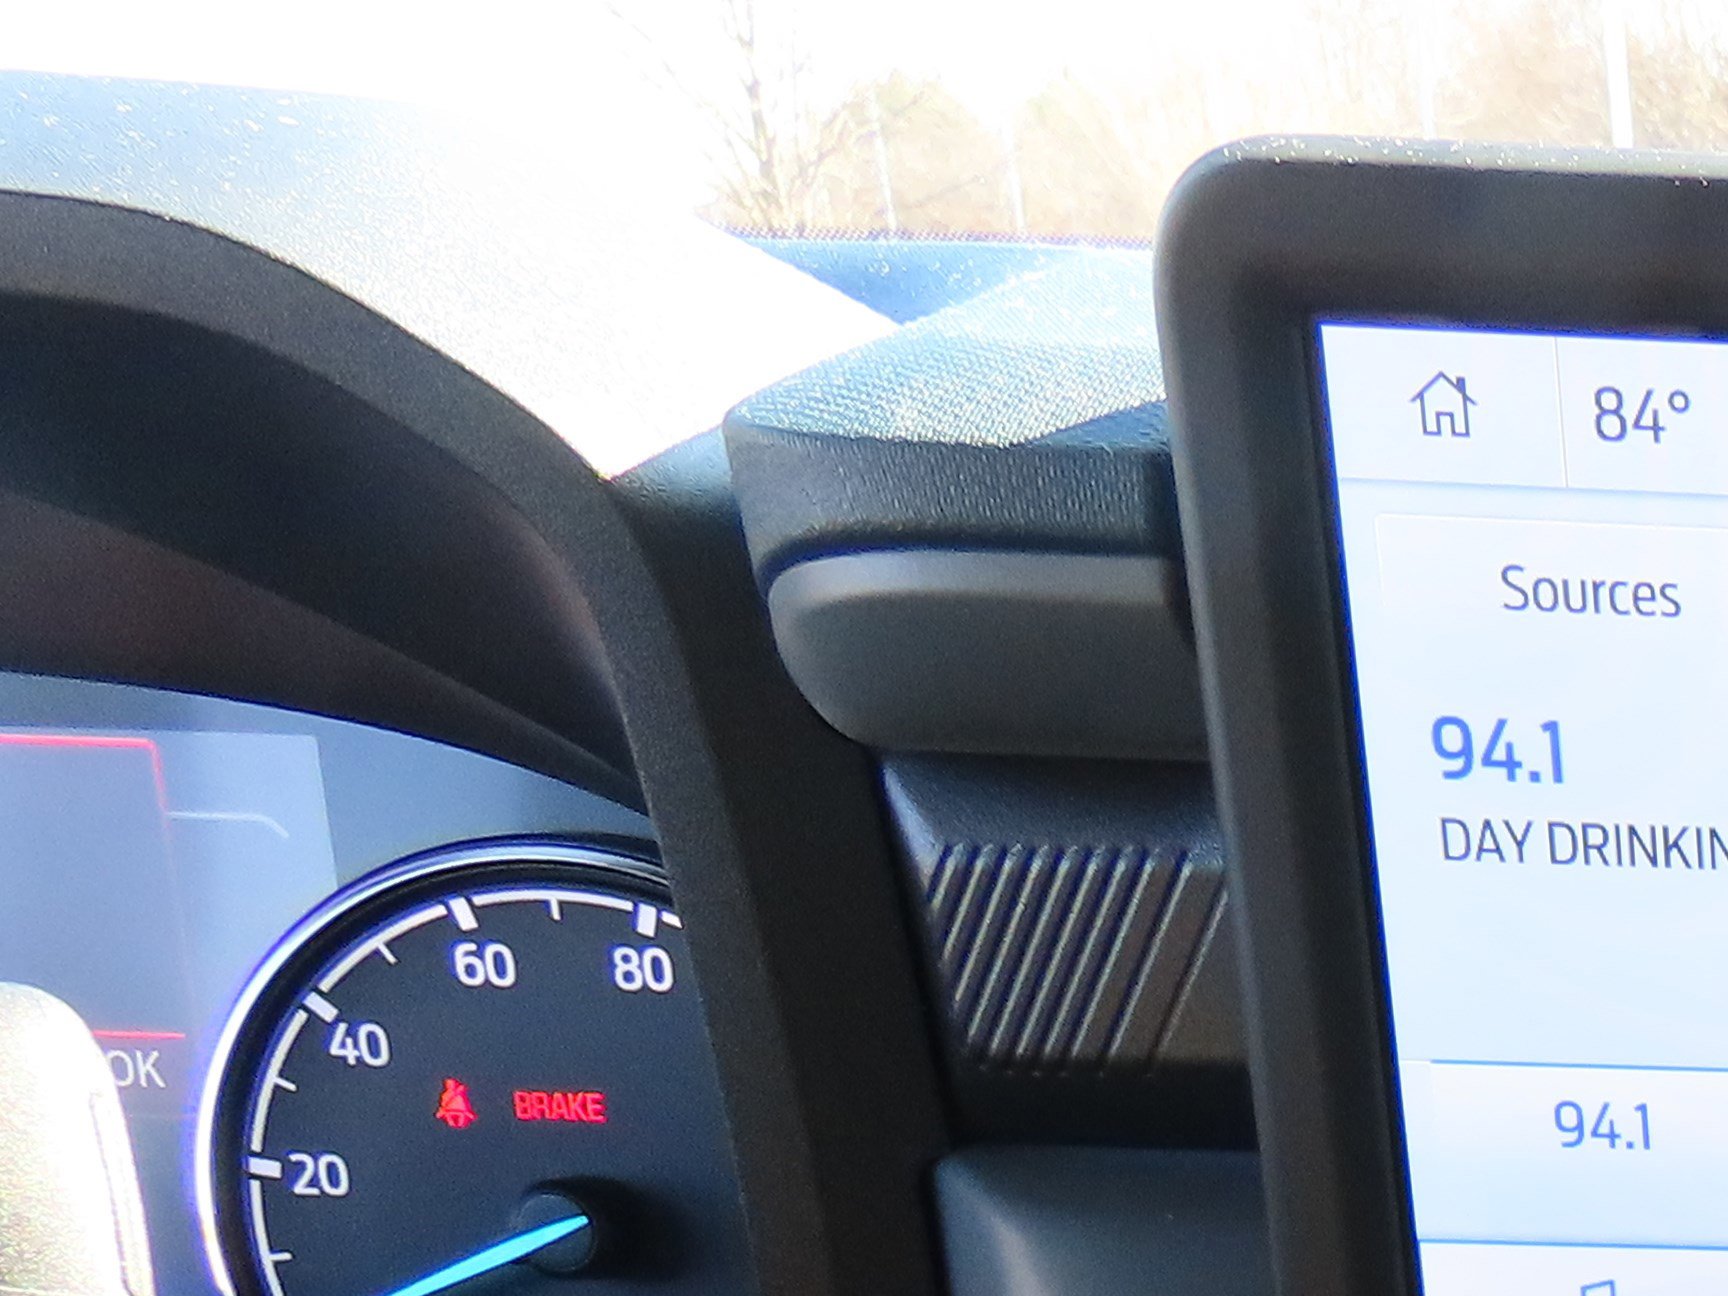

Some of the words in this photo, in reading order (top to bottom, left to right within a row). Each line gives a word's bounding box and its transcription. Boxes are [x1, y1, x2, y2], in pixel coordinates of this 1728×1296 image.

[1500, 564, 1682, 618] Sources
[1431, 716, 1563, 784] 94.1
[1440, 817, 1533, 864] DAY
[454, 944, 516, 987] 60
[613, 946, 673, 992] 80
[327, 1022, 390, 1067] 40
[106, 1050, 166, 1088] OK
[512, 1090, 608, 1124] BRAKE
[1554, 1101, 1651, 1150] 94.1
[288, 1153, 349, 1196] 20
